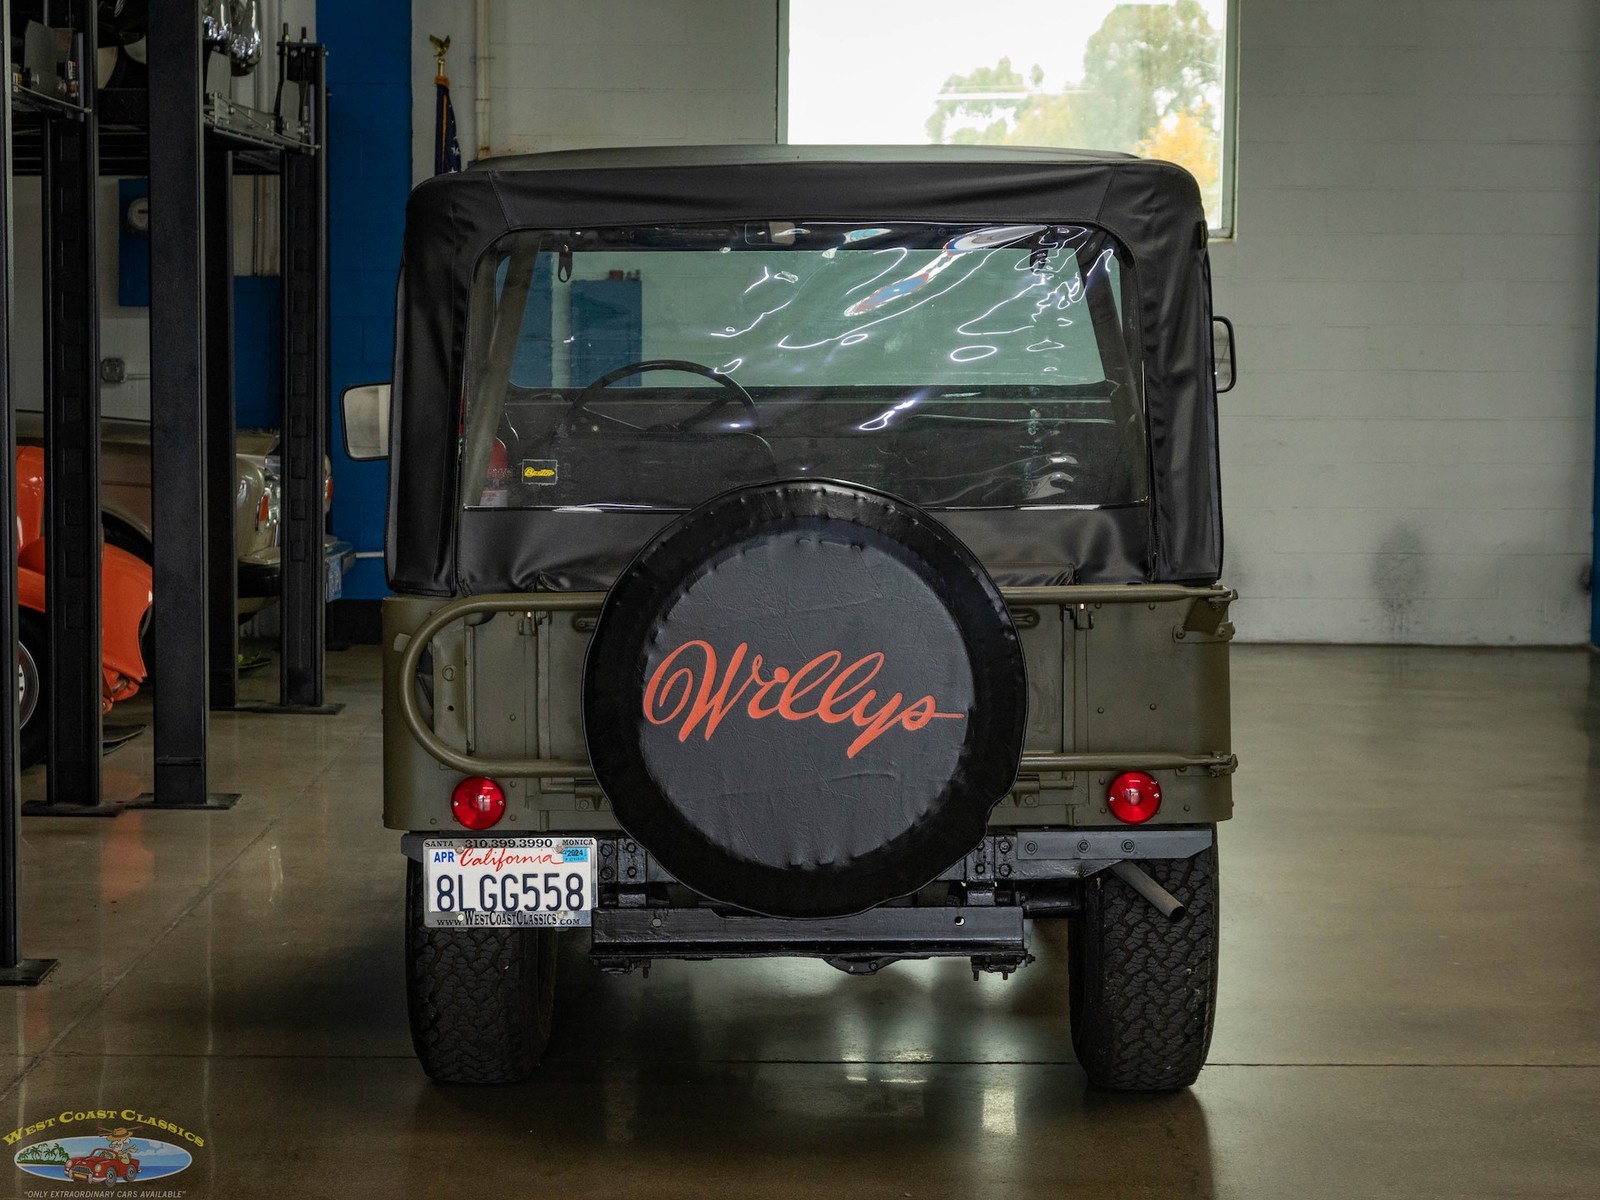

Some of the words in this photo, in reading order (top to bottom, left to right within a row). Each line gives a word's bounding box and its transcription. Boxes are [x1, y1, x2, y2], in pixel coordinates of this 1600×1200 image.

[643, 639, 965, 759] Willys
[424, 840, 454, 848] SANTA
[465, 838, 553, 849] 310.399.3990
[433, 851, 455, 863] APR
[460, 848, 564, 873] California
[567, 849, 584, 857] 2024
[436, 872, 585, 912] 8LGG558
